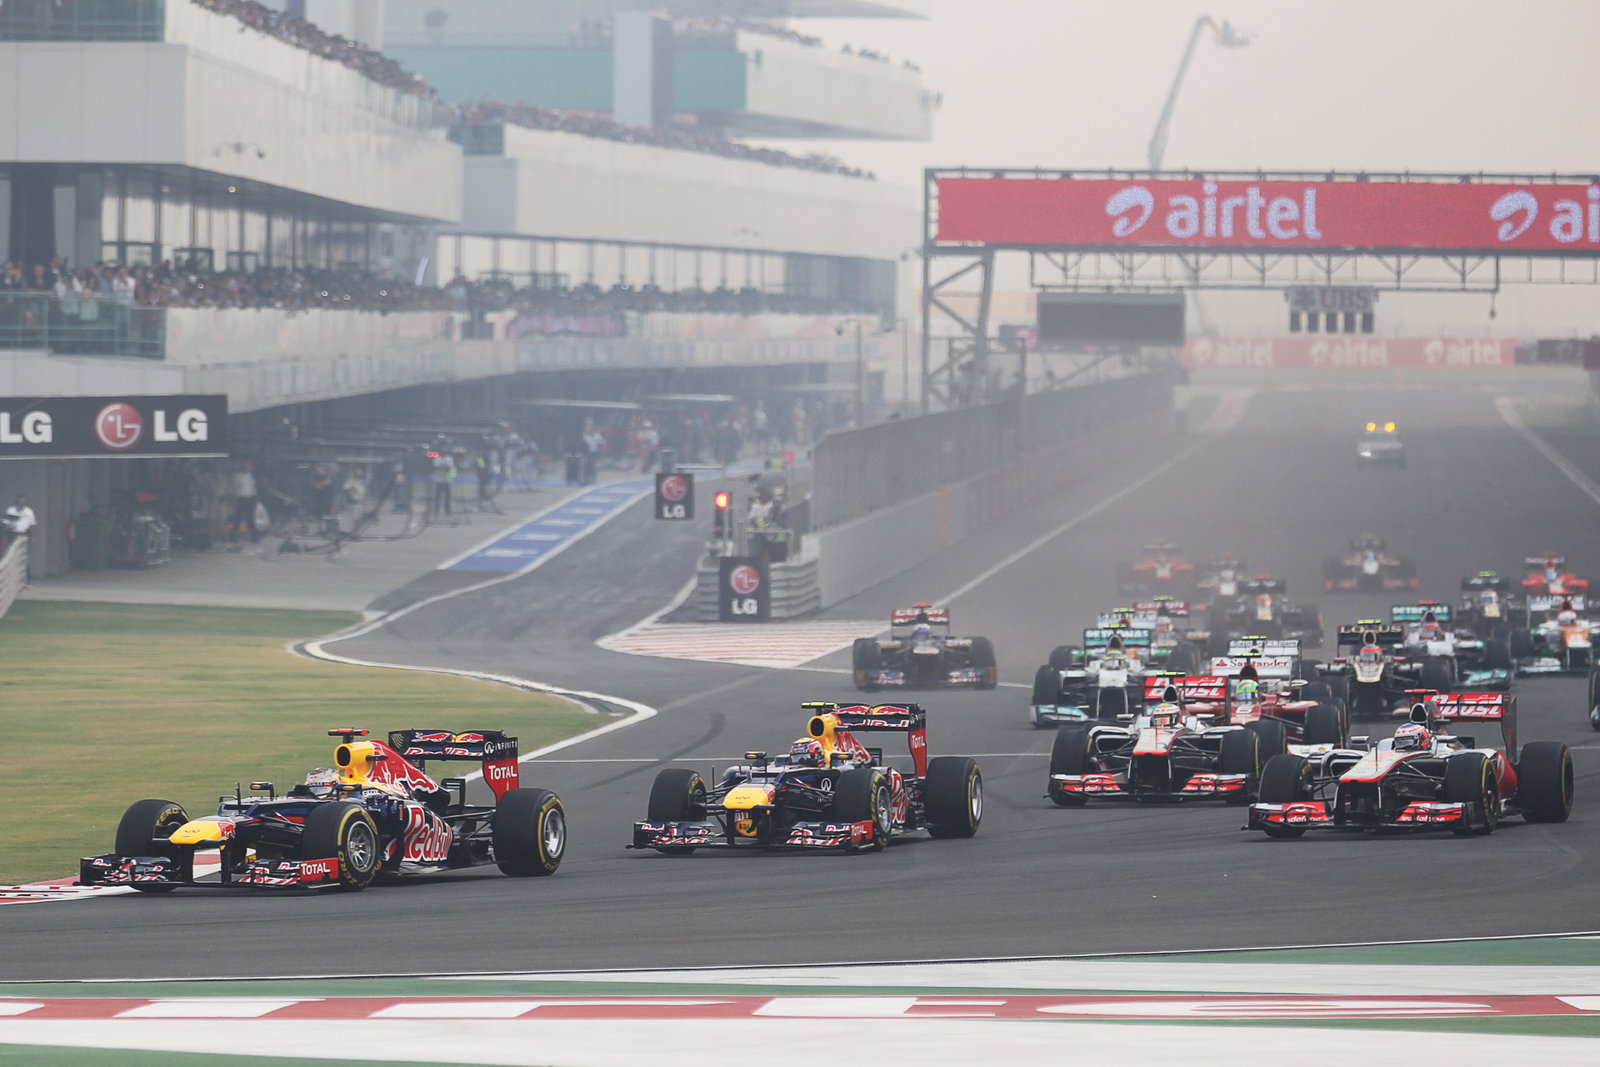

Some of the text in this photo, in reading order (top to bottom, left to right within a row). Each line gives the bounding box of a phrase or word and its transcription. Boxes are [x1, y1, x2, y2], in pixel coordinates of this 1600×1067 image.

[1166, 180, 1322, 240] airtel
[1215, 340, 1273, 366] airtel
[1331, 340, 1389, 366] airtel
[1446, 340, 1502, 366] airtel
[0, 411, 52, 444] LG
[153, 409, 208, 442] LG
[662, 504, 686, 518] LG
[731, 598, 758, 615] LG
[1341, 625, 1402, 633] LOUS
[488, 764, 518, 780] TOTAL
[300, 863, 331, 876] TOTAL
[0, 995, 1600, 1018] irte
